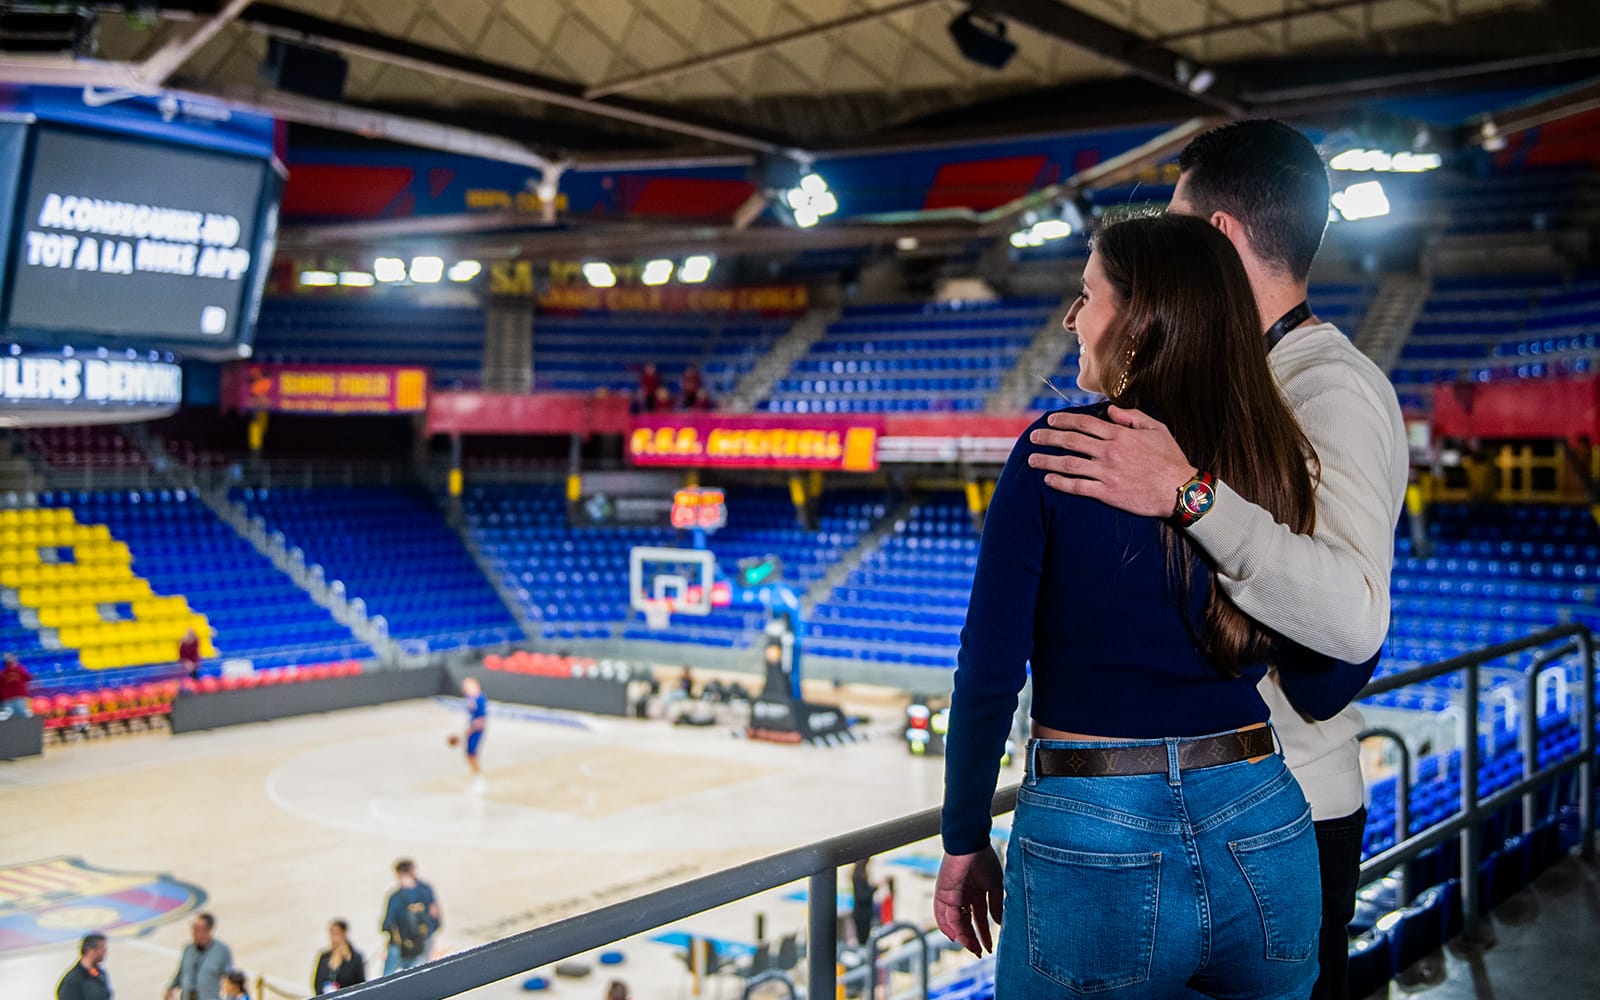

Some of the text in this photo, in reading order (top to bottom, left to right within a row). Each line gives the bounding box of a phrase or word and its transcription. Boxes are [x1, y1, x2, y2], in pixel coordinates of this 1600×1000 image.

[27, 231, 78, 268] TOT
[75, 236, 99, 271] A
[101, 240, 134, 275] LA
[197, 247, 251, 280] APP
